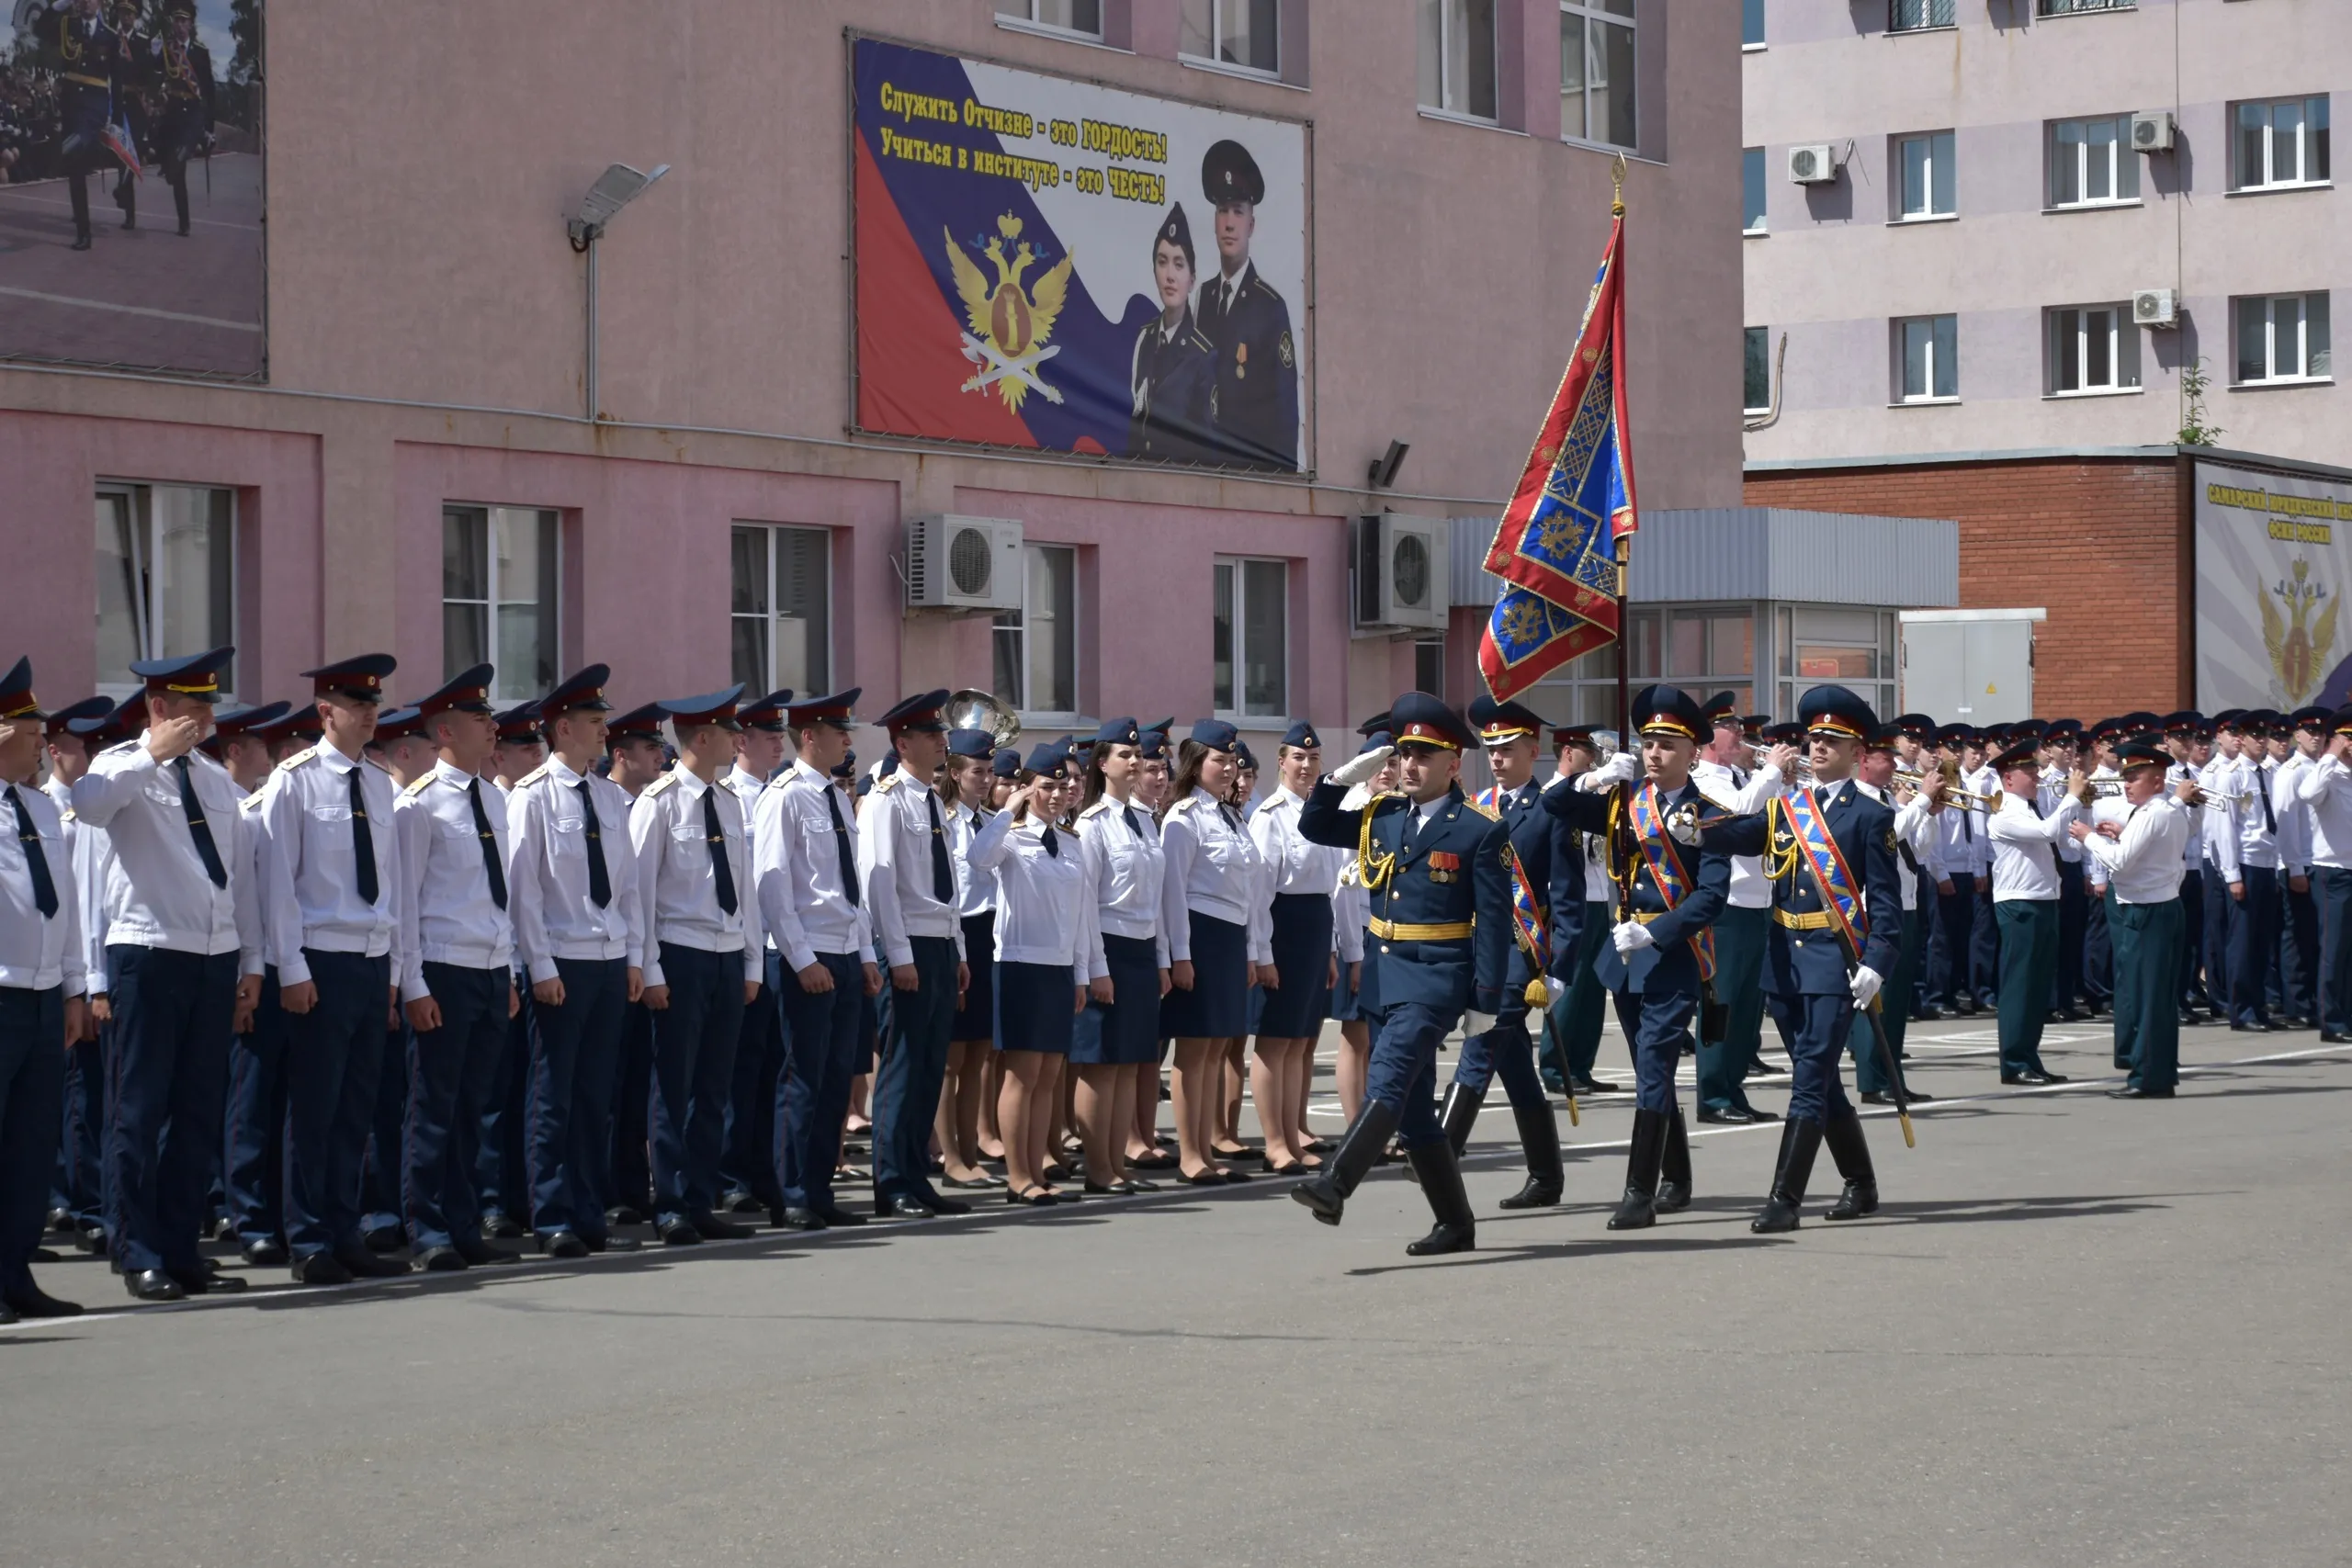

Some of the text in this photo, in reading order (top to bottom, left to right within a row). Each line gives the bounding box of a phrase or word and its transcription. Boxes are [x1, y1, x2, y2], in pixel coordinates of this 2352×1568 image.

[880, 82, 957, 122] Служить
[964, 98, 1033, 138] Отчизне
[1050, 119, 1077, 146] это
[1081, 118, 1168, 164] ГОРДОСТЬ!
[880, 127, 952, 166] Учиться
[957, 148, 967, 169] в
[974, 151, 1059, 192] институте
[1077, 167, 1104, 195] это
[1107, 166, 1165, 206] ЧЕСТЬ!
[2208, 482, 2267, 512] САМАРСКИЙ
[2268, 492, 2335, 520] ЮРИДИЧЕСКИЙ
[2267, 518, 2332, 545] ФСИН РОССИИ
